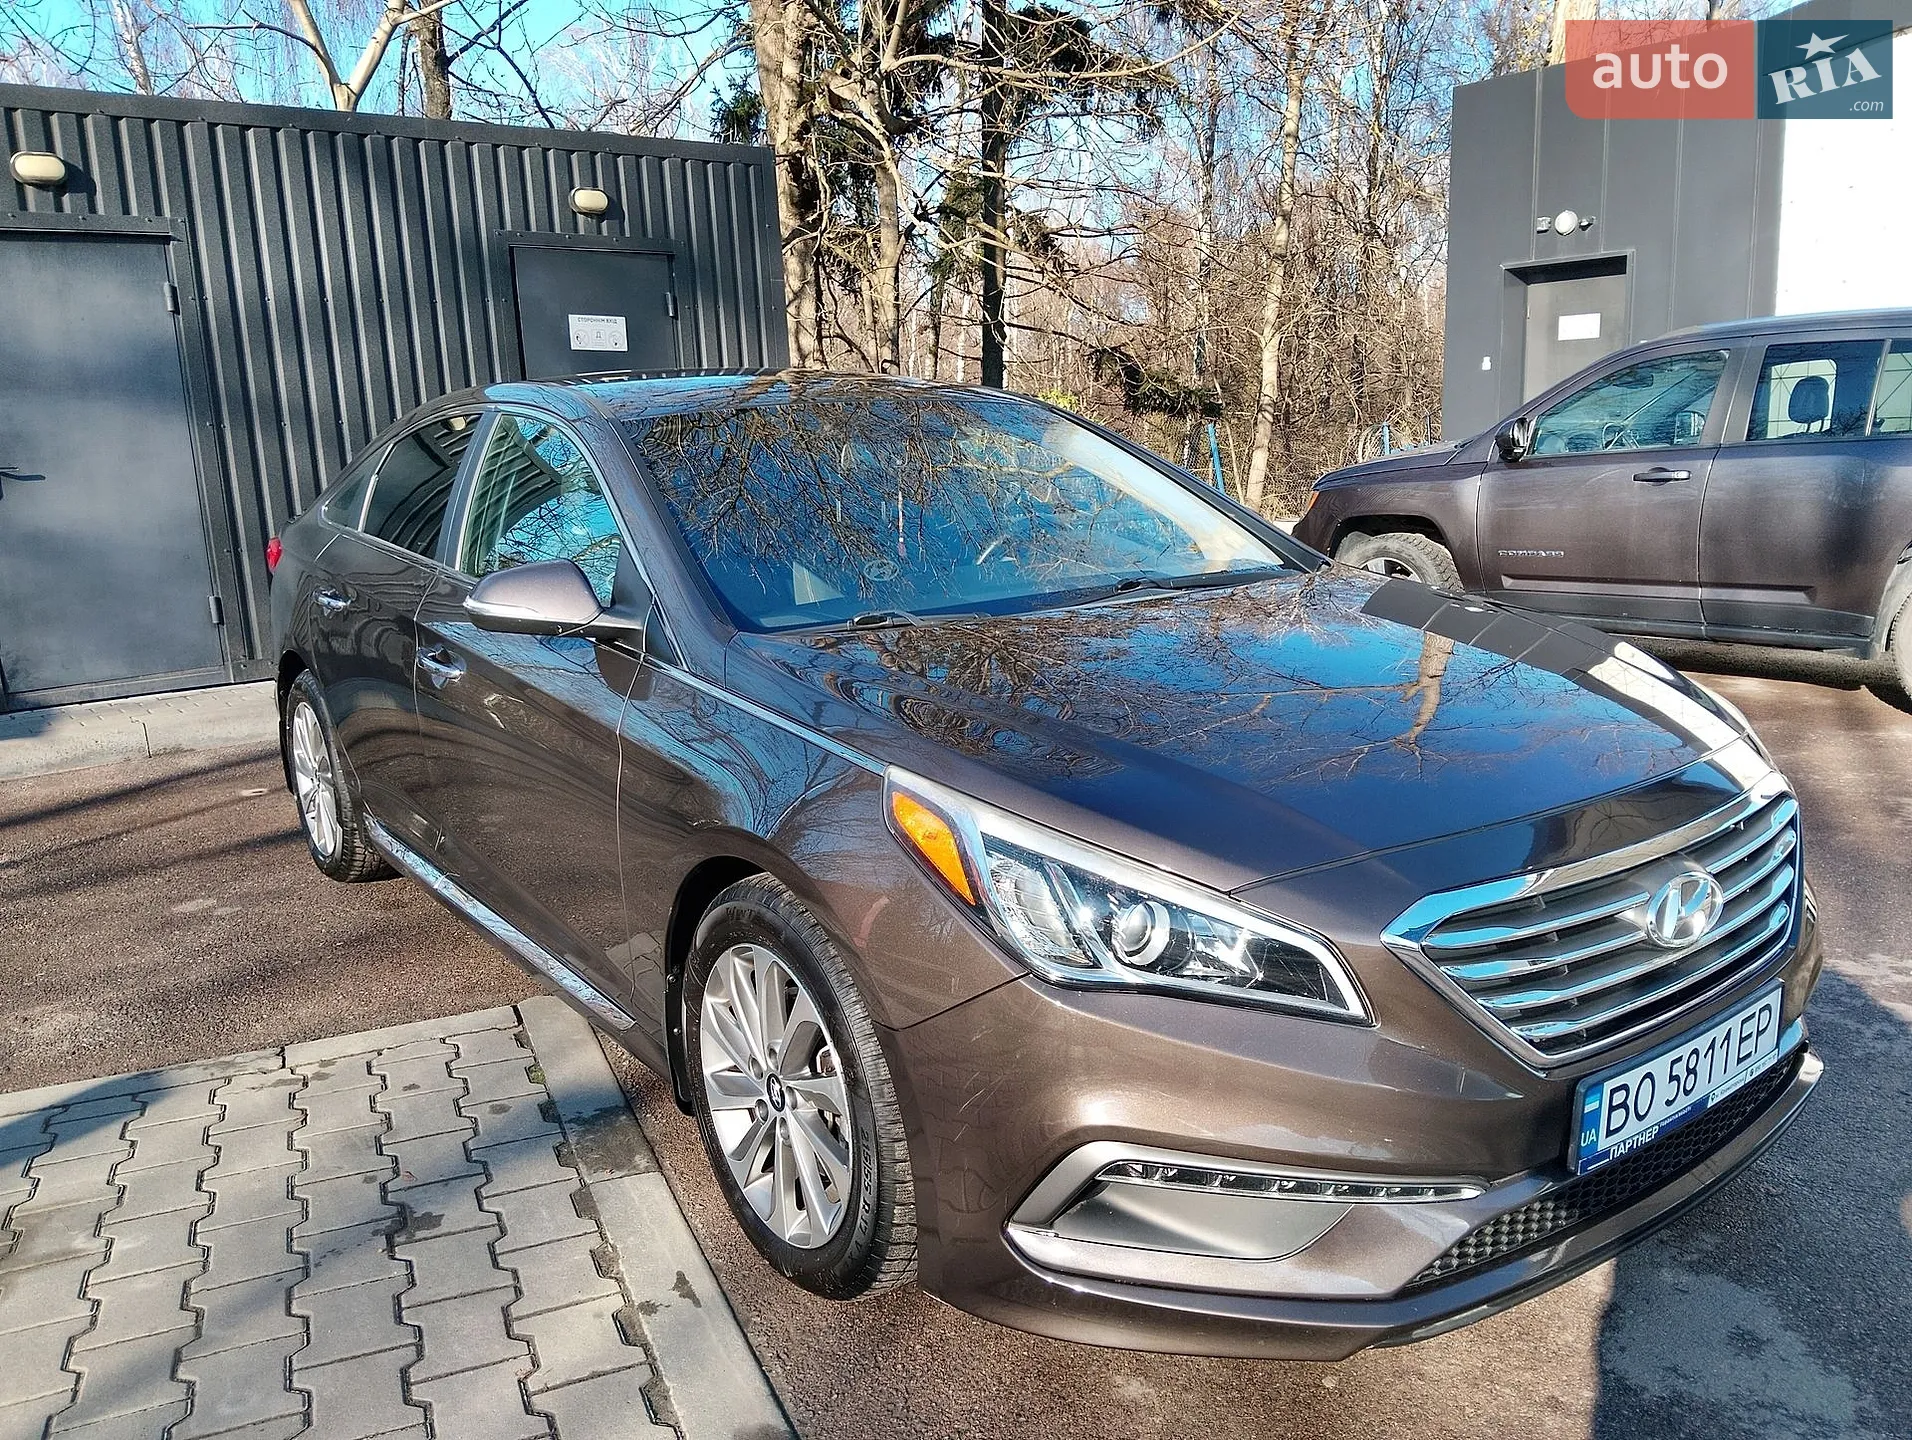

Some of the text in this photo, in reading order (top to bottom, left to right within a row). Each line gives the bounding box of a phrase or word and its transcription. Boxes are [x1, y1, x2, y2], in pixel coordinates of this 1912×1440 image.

[1604, 1071, 1656, 1139] BO
[1580, 1130, 1597, 1147] UA
[1609, 1125, 1660, 1161] ПАРТНЕР
